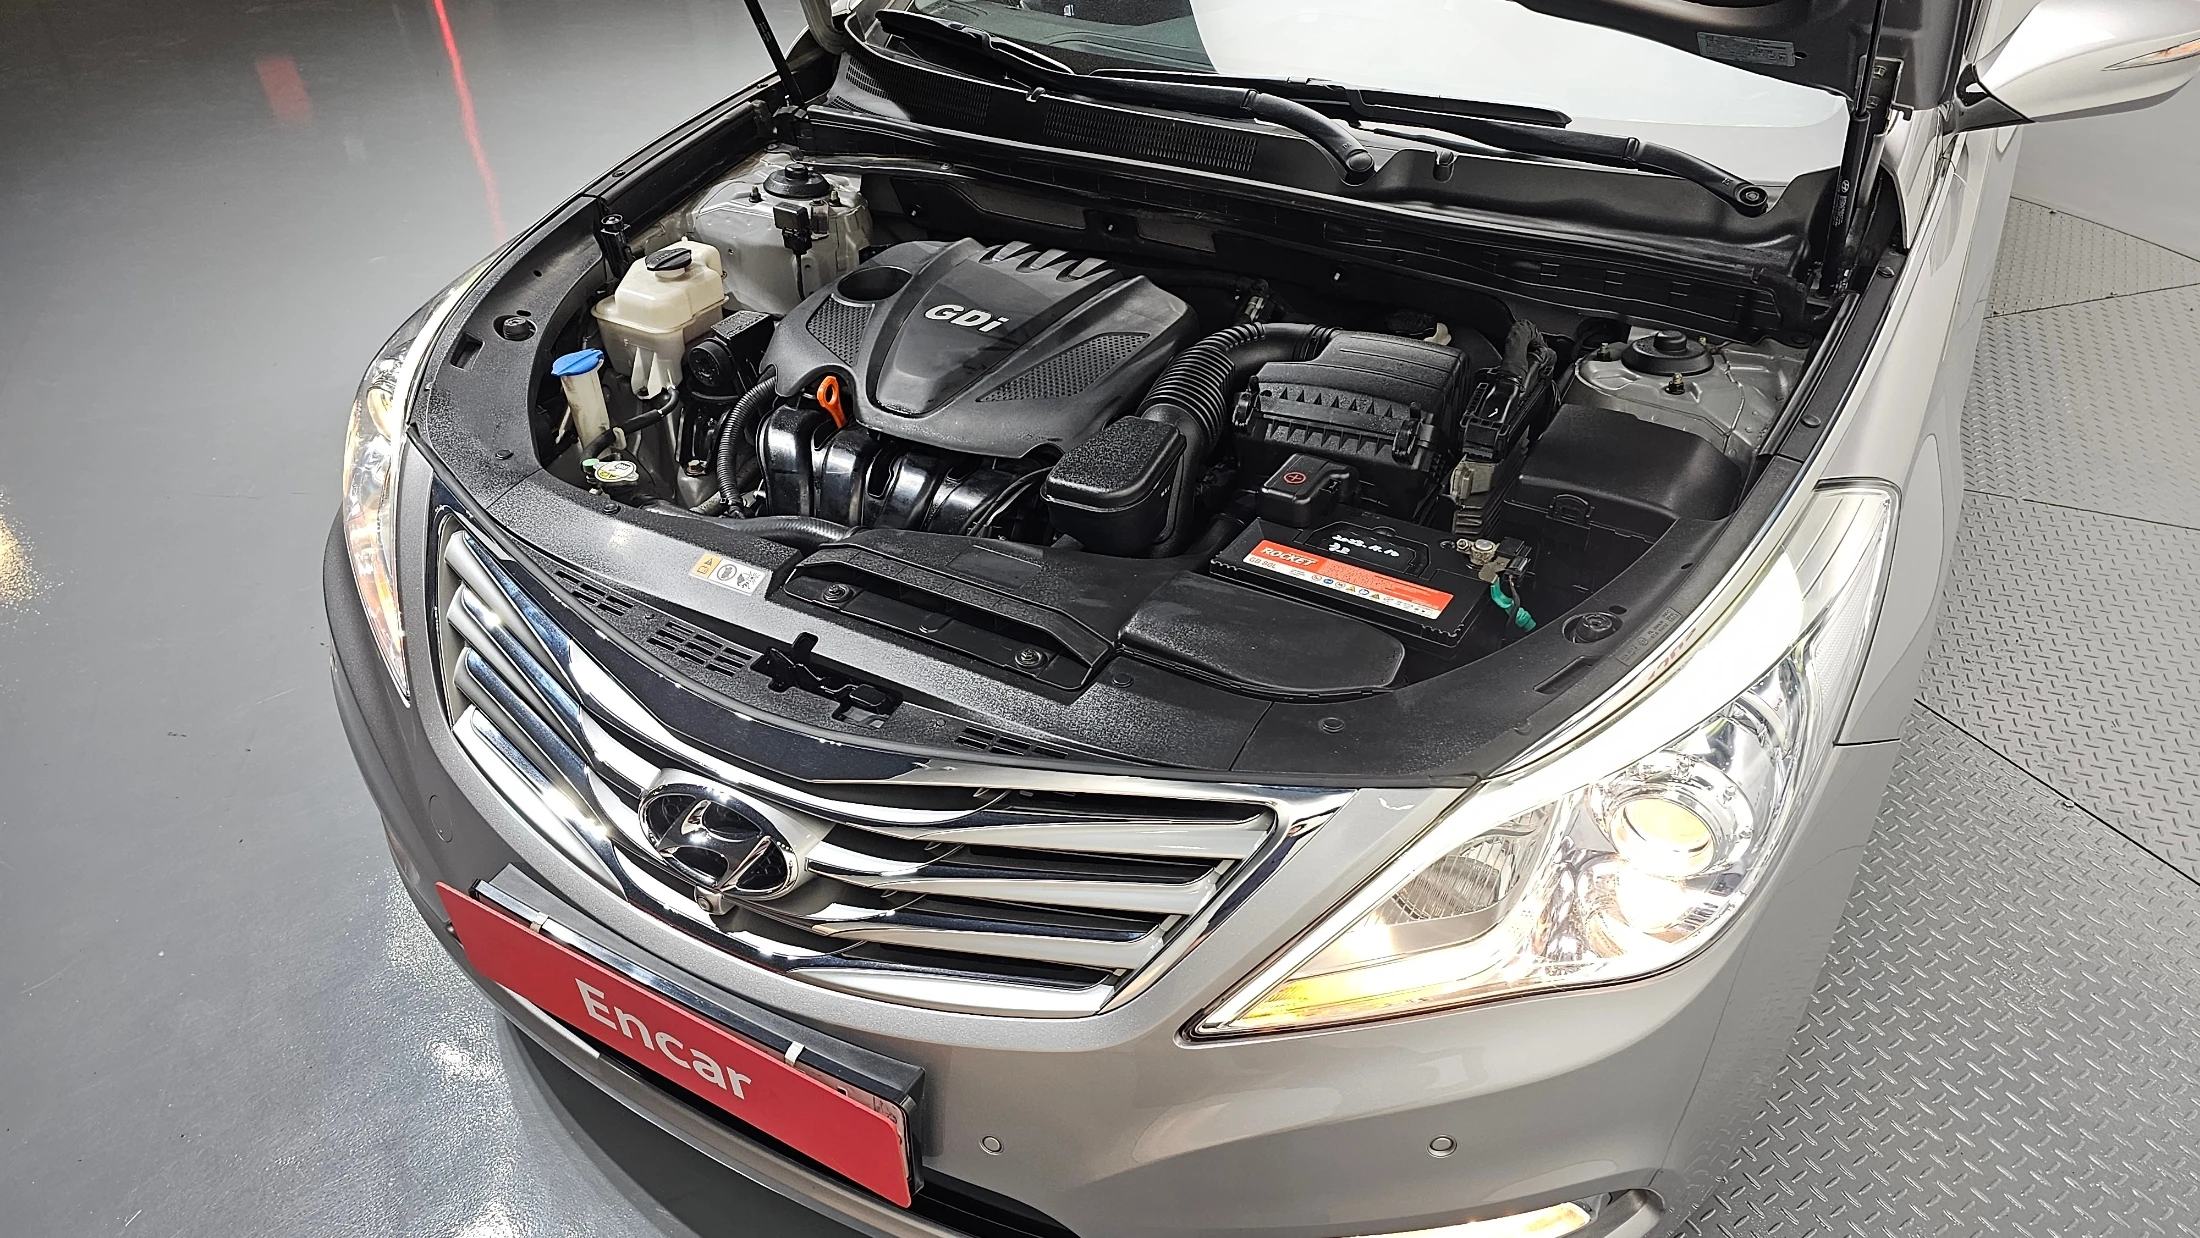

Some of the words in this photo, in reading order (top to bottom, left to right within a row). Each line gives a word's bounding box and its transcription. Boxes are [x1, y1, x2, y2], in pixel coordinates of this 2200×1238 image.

[925, 304, 1010, 333] GDi
[1260, 547, 1319, 566] ROCKET
[574, 977, 752, 1100] Encar
